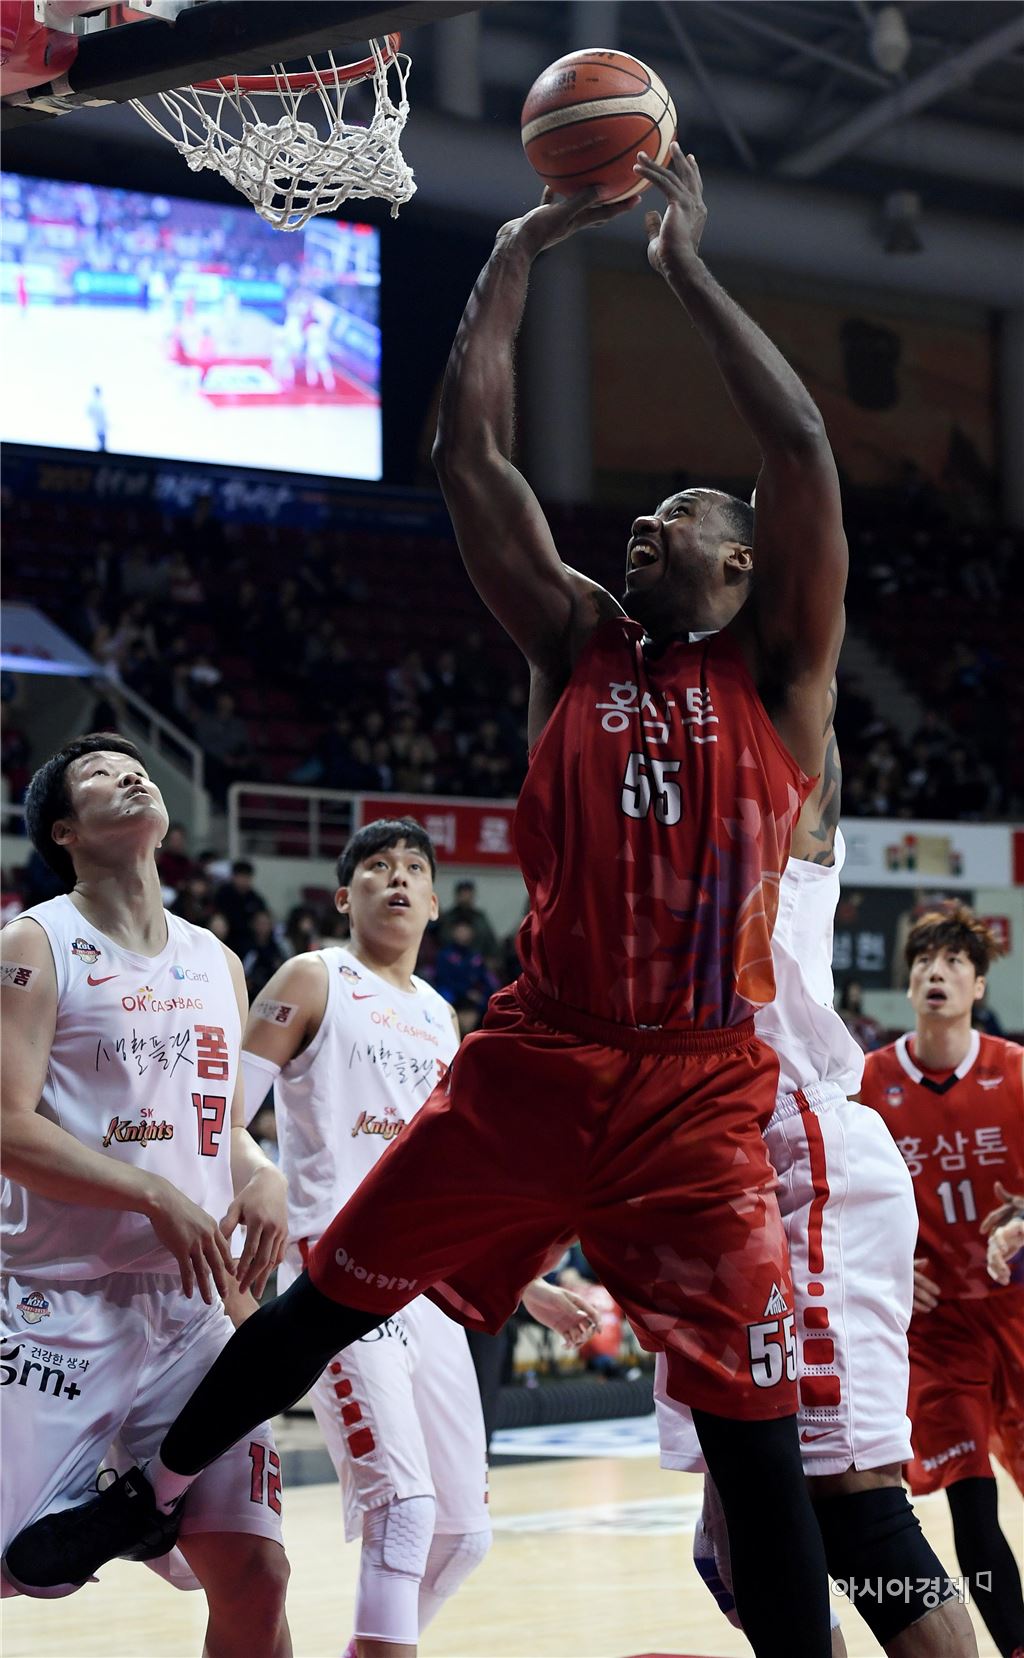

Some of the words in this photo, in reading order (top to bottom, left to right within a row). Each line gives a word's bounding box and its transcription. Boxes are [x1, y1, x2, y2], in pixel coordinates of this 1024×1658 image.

[621, 752, 682, 826] 55
[121, 994, 147, 1012] OK
[370, 1011, 391, 1029] OK
[140, 1107, 154, 1118] SK
[191, 1093, 227, 1157] 12
[351, 1110, 410, 1140] Knigh
[384, 1106, 397, 1117] SK
[896, 1127, 1008, 1177] 홍삼톤
[937, 1179, 977, 1224] 11
[31, 1346, 64, 1367] 건강한
[67, 1356, 90, 1373] 생각
[746, 1313, 798, 1388] 55
